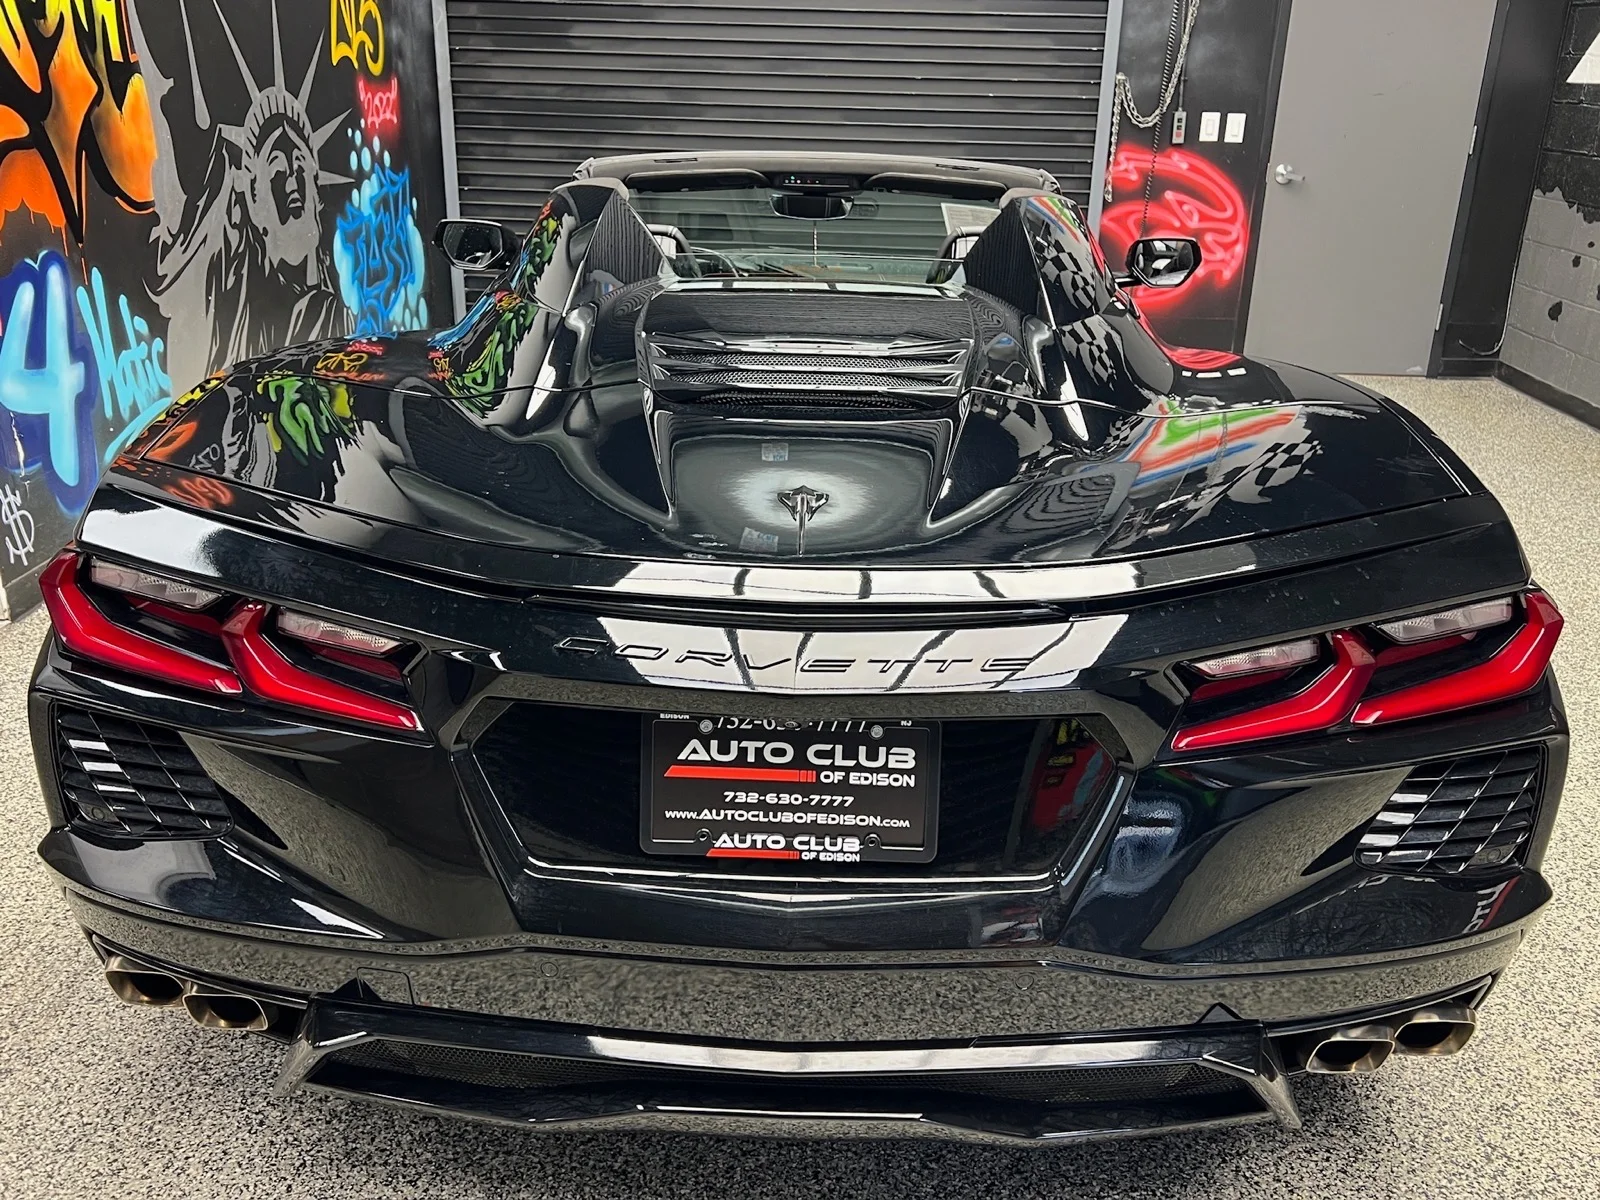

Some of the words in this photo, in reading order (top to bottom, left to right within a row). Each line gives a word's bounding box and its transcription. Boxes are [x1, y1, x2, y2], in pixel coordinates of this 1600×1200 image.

[553, 636, 1034, 674] CORVETTE
[677, 738, 795, 764] AUTO
[806, 743, 916, 770] CLUB
[820, 770, 845, 784] OF
[849, 772, 915, 788] EDISON
[723, 791, 854, 807] 732-630-7777
[713, 833, 786, 849] AUTO
[793, 836, 860, 852] CLUB
[801, 851, 817, 860] OF
[819, 852, 860, 862] EDISON
